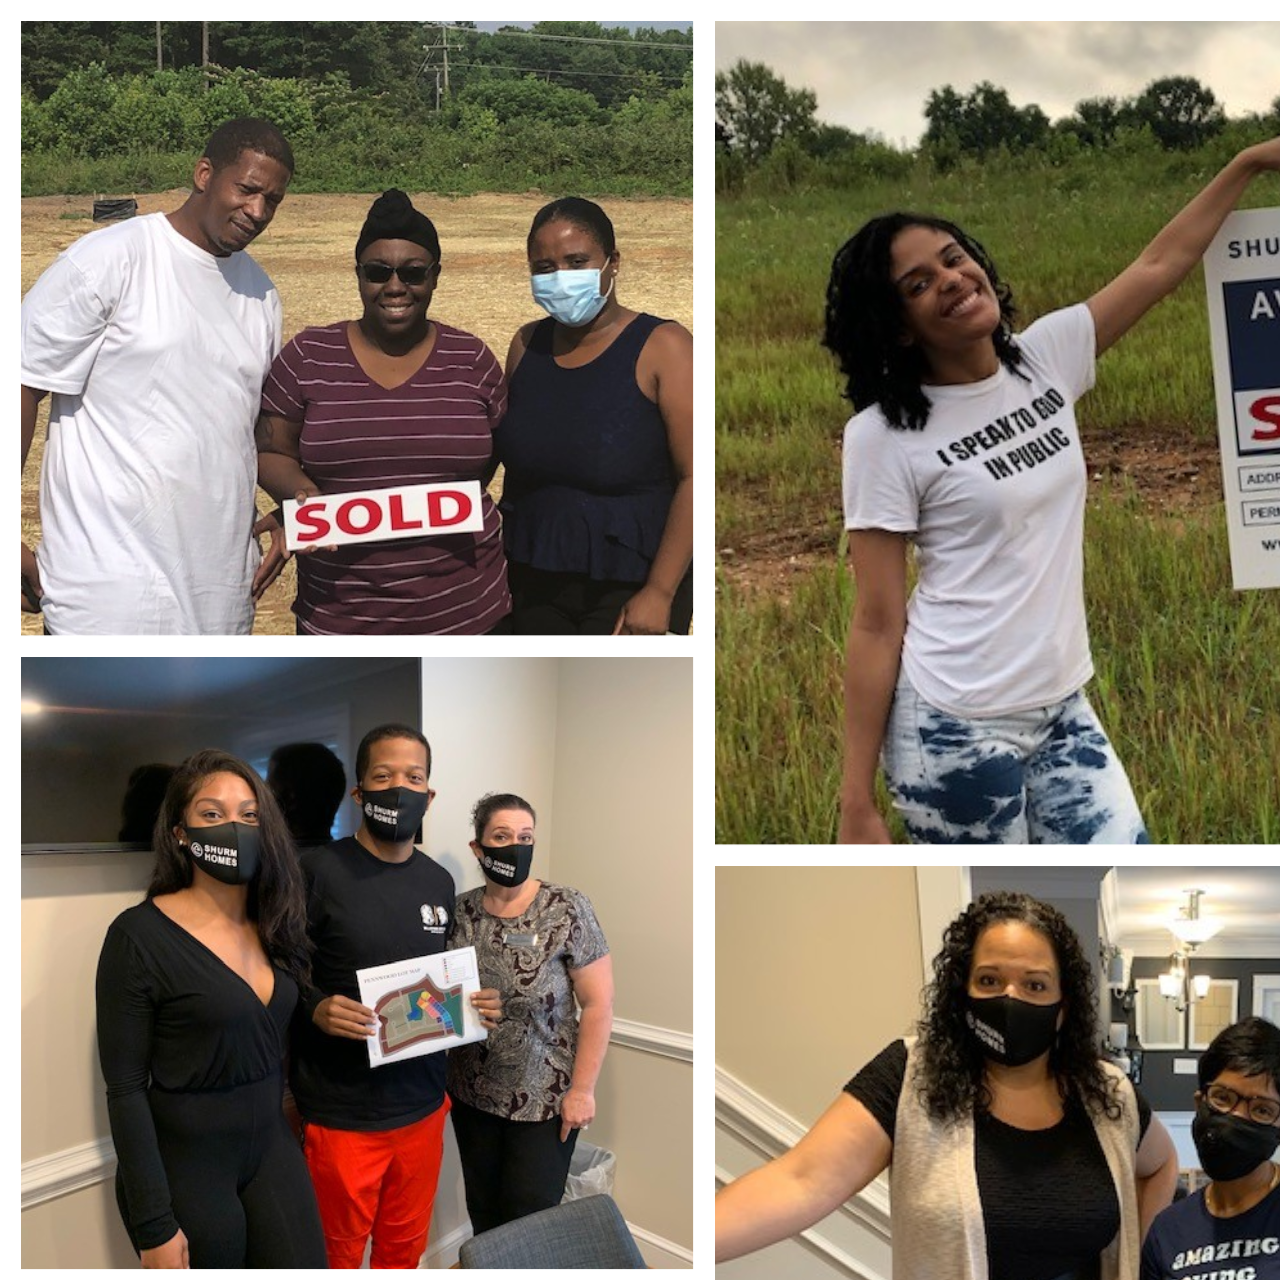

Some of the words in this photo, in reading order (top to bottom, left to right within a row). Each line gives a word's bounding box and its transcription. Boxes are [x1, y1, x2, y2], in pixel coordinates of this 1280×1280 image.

[936, 449, 953, 467] I
[949, 416, 1017, 461] SPEAK
[1011, 408, 1037, 433] TO
[1032, 388, 1065, 421] GOD
[984, 456, 1013, 480] IN
[1007, 427, 1070, 473] PUBLIC
[295, 490, 472, 542] SOLD
[204, 844, 238, 857] SHURM
[204, 853, 238, 867] HOMES
